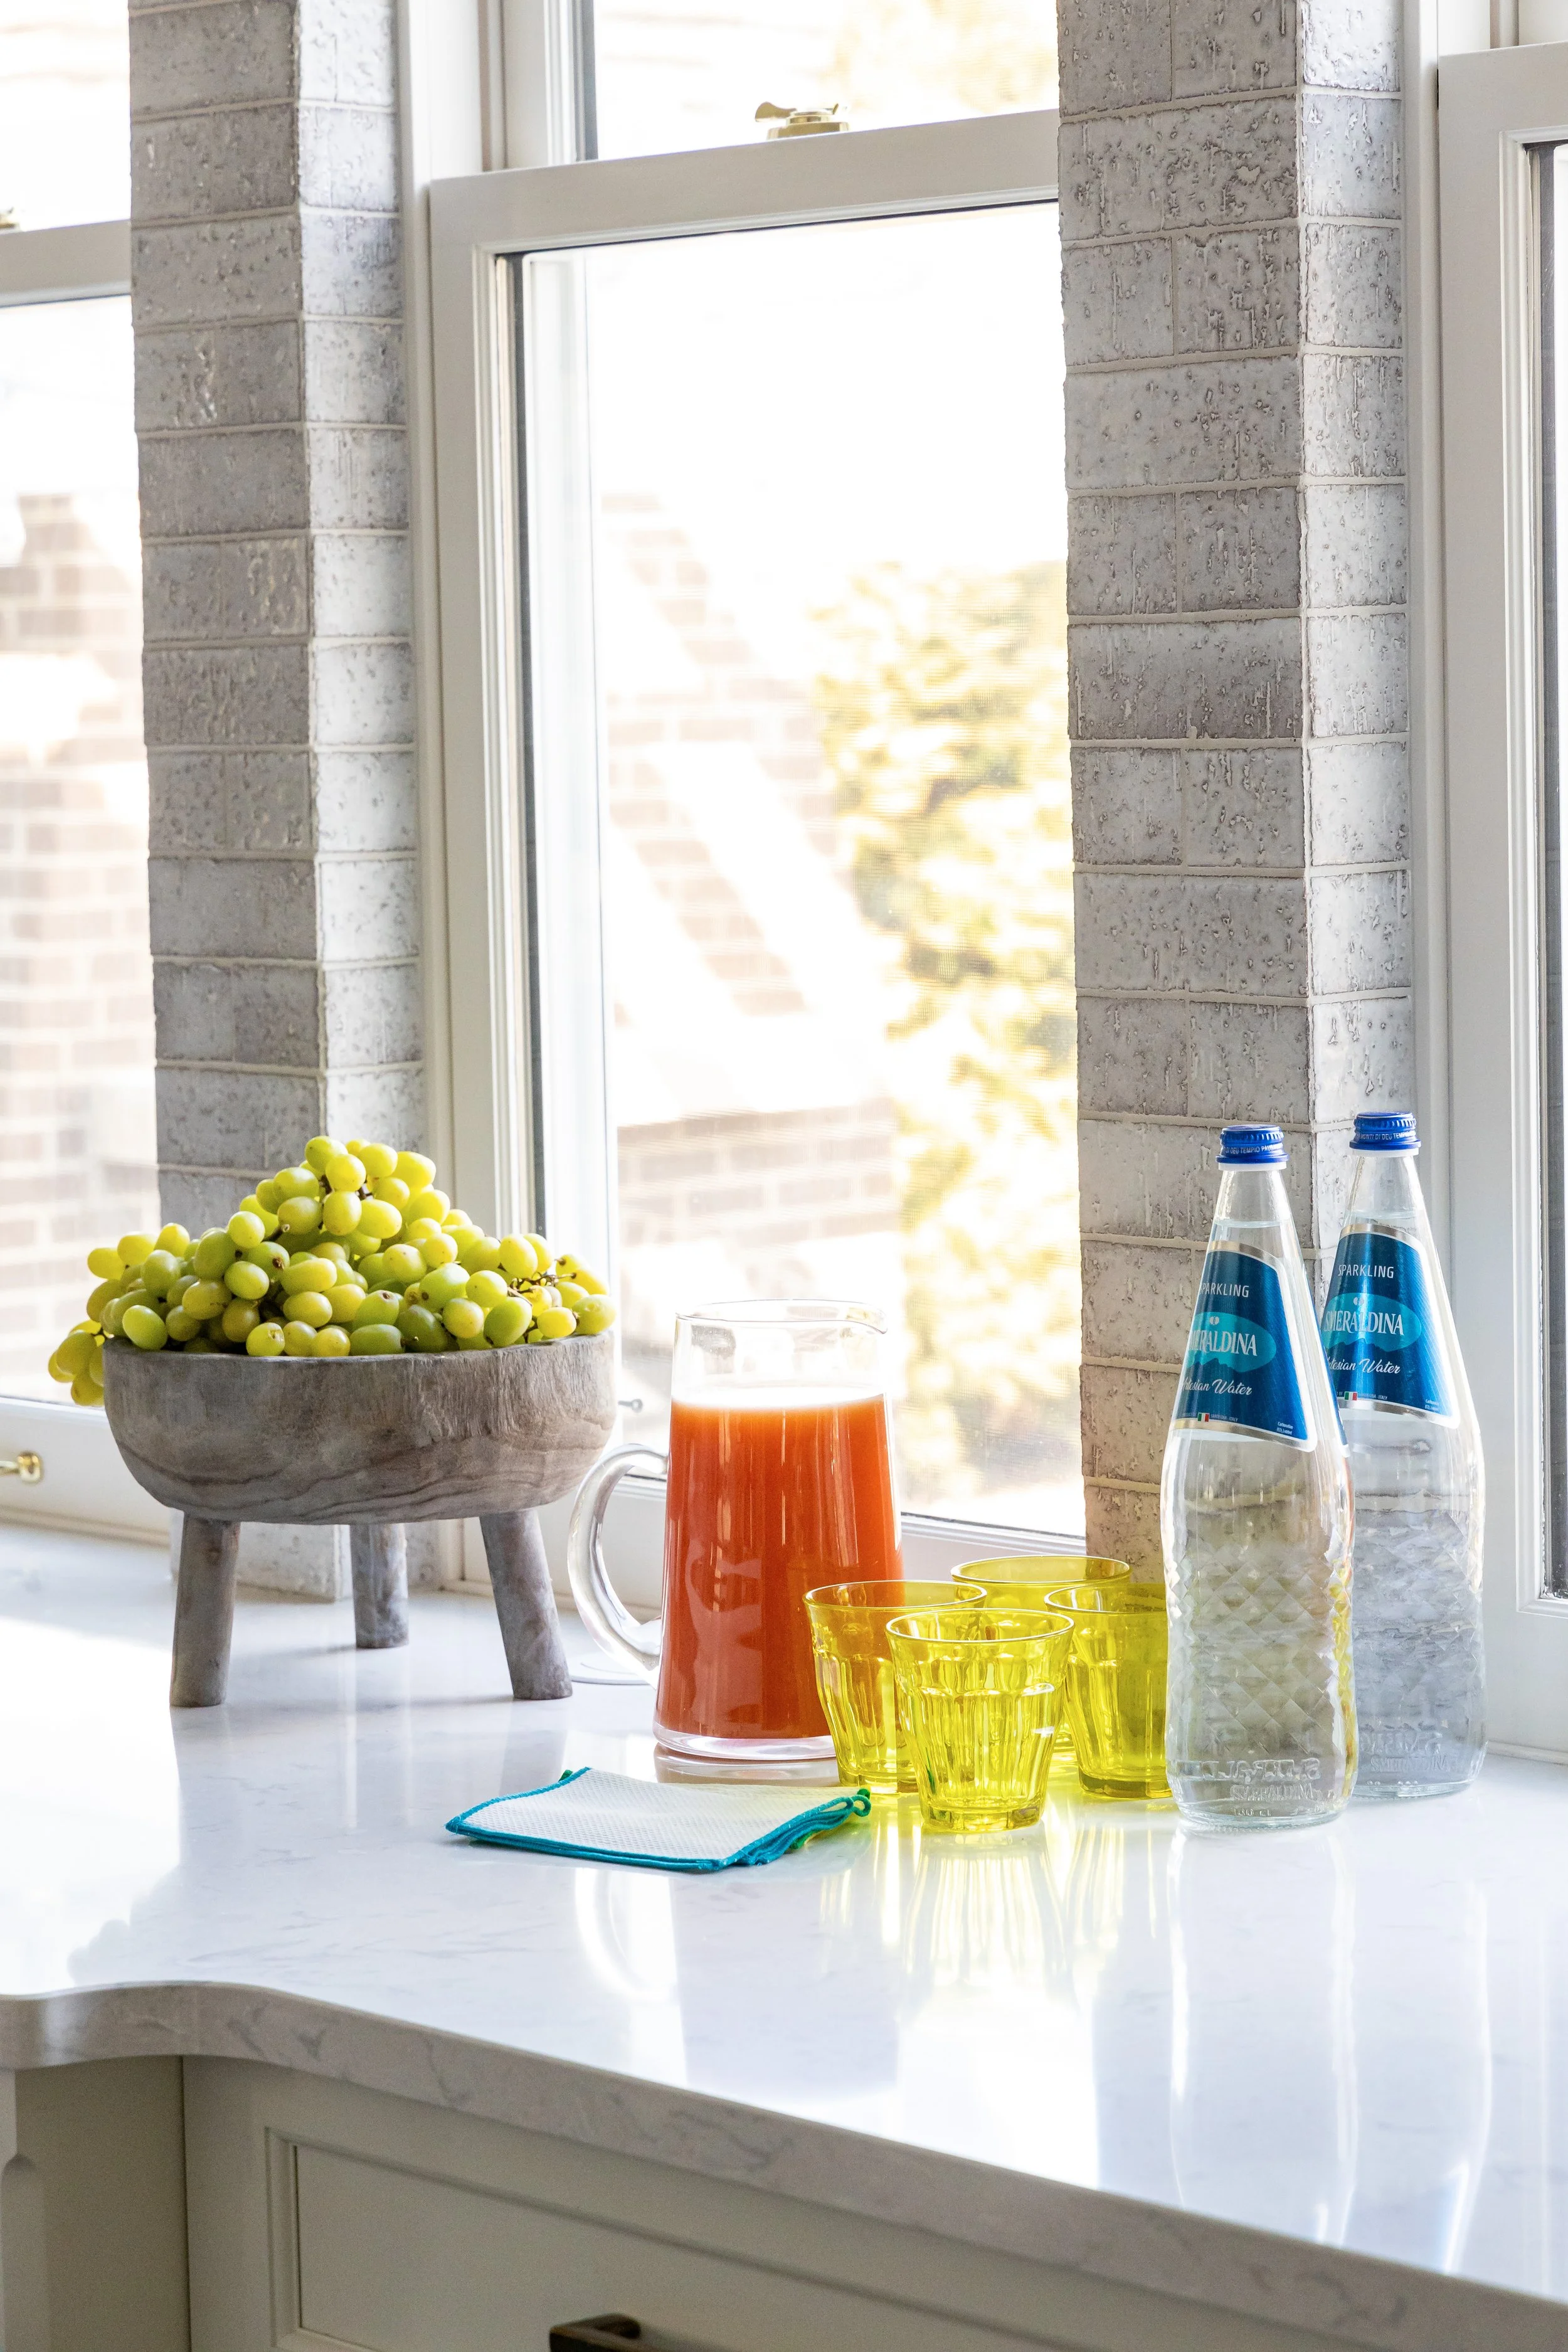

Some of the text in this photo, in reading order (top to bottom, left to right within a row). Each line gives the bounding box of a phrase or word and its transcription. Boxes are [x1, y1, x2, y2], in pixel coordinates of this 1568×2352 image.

[1240, 1146, 1261, 1154] TEMPIO
[1338, 1264, 1394, 1279] SPARKLING
[1324, 1310, 1404, 1336] SMERALDINA
[1359, 1358, 1401, 1374] Water
[1212, 1379, 1253, 1396] Water
